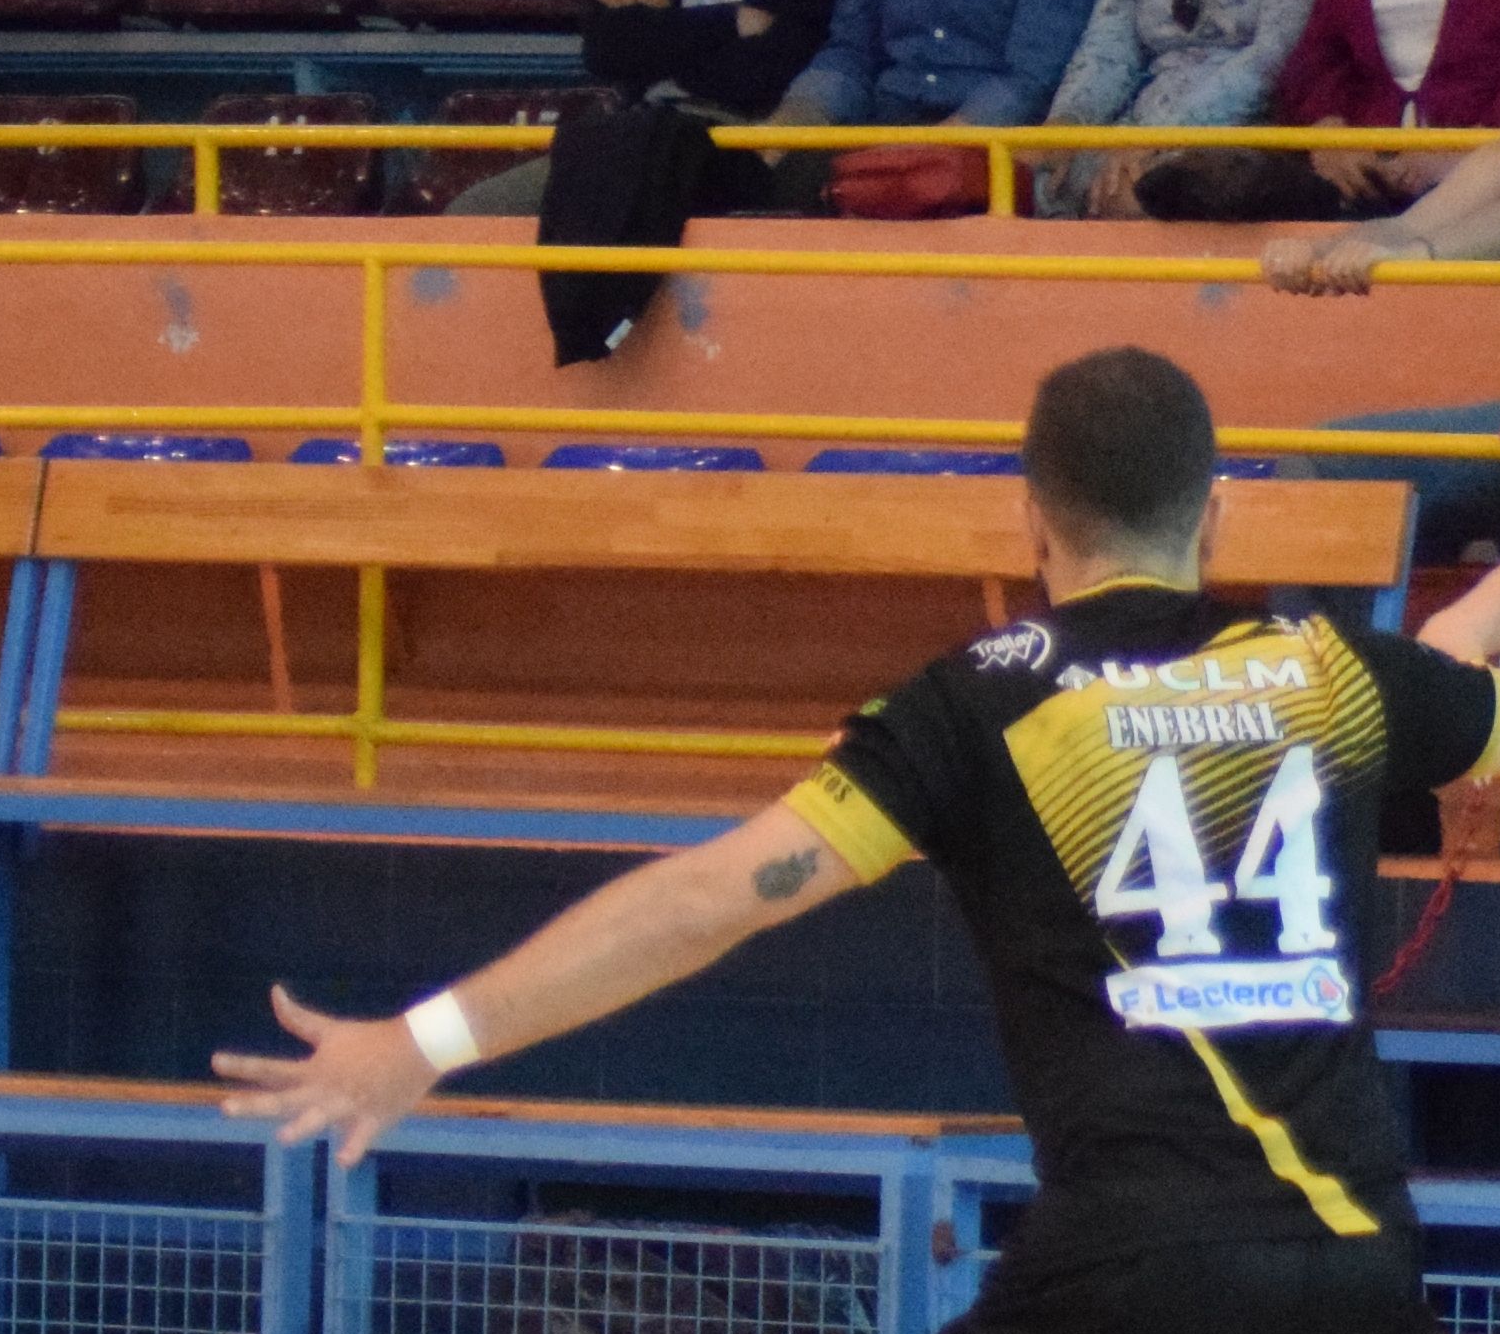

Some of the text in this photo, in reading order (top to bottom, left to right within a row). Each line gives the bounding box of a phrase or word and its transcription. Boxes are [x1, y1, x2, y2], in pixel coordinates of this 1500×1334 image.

[1102, 658, 1309, 692] UCLM
[1105, 700, 1285, 749] ENEBRAL
[1094, 744, 1337, 958] 44
